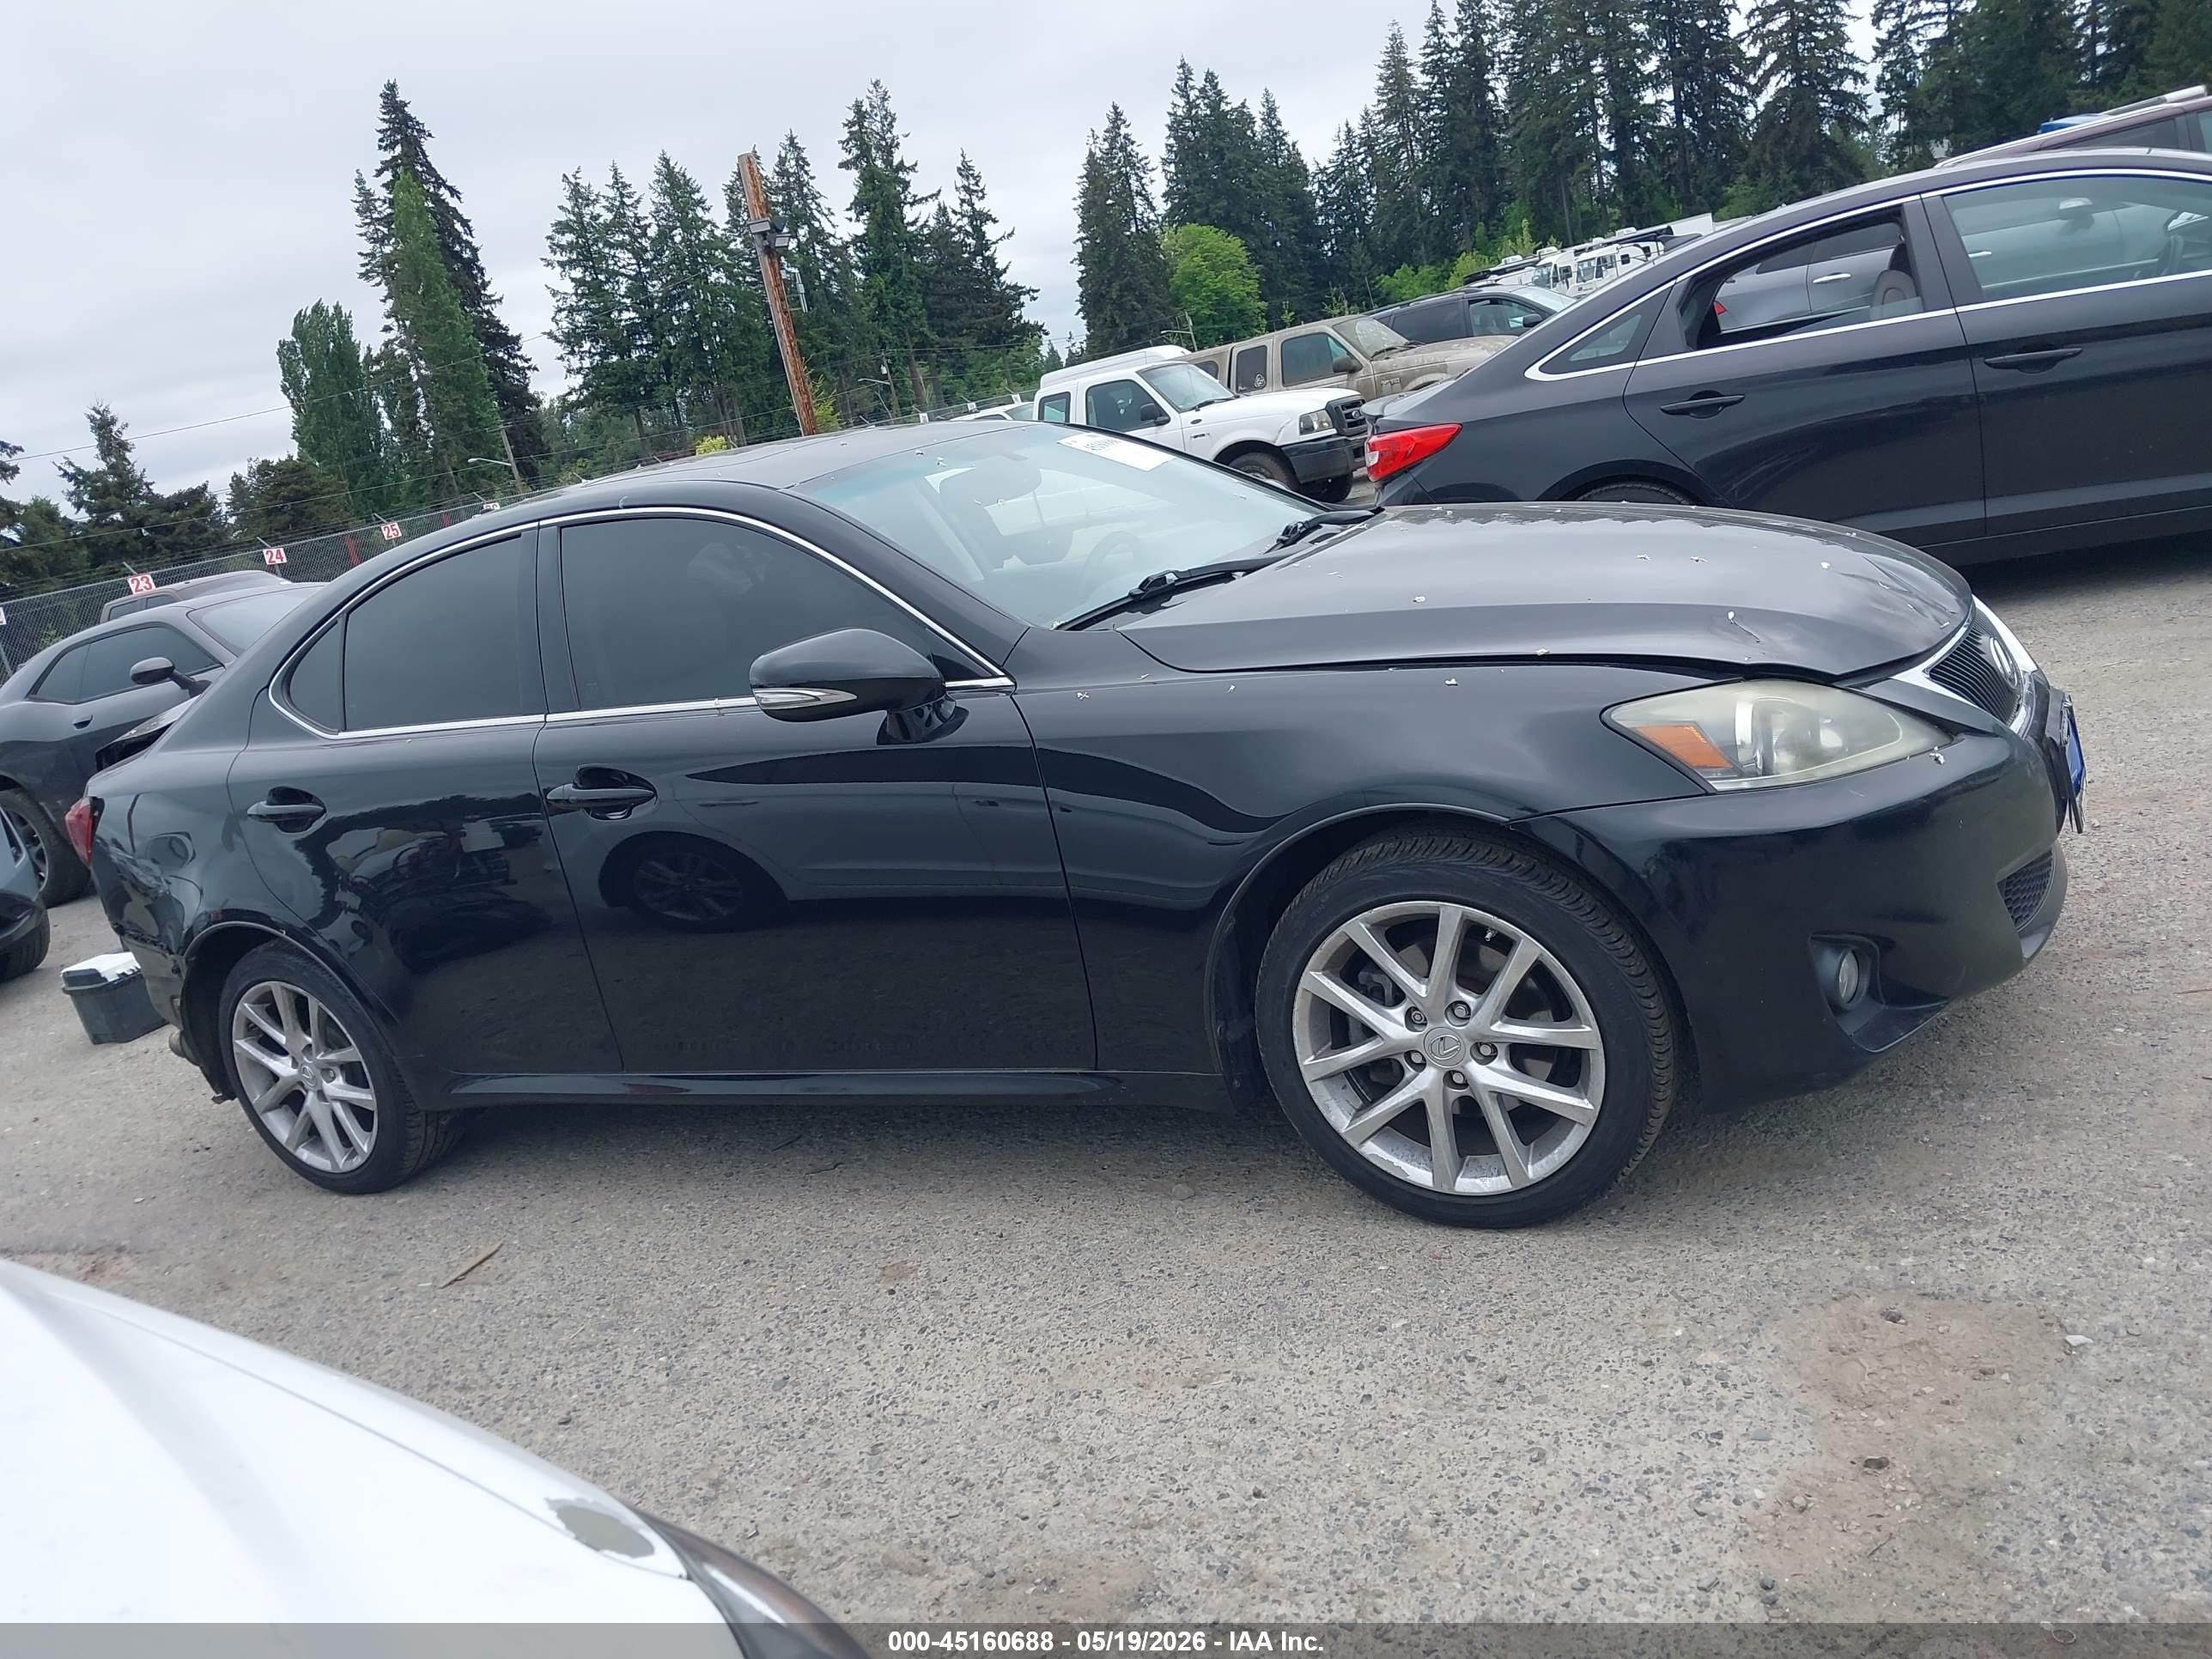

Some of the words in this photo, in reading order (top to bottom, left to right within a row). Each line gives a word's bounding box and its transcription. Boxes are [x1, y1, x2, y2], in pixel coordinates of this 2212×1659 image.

[383, 524, 399, 538] 25
[265, 549, 284, 564] 24
[131, 575, 153, 592] 23
